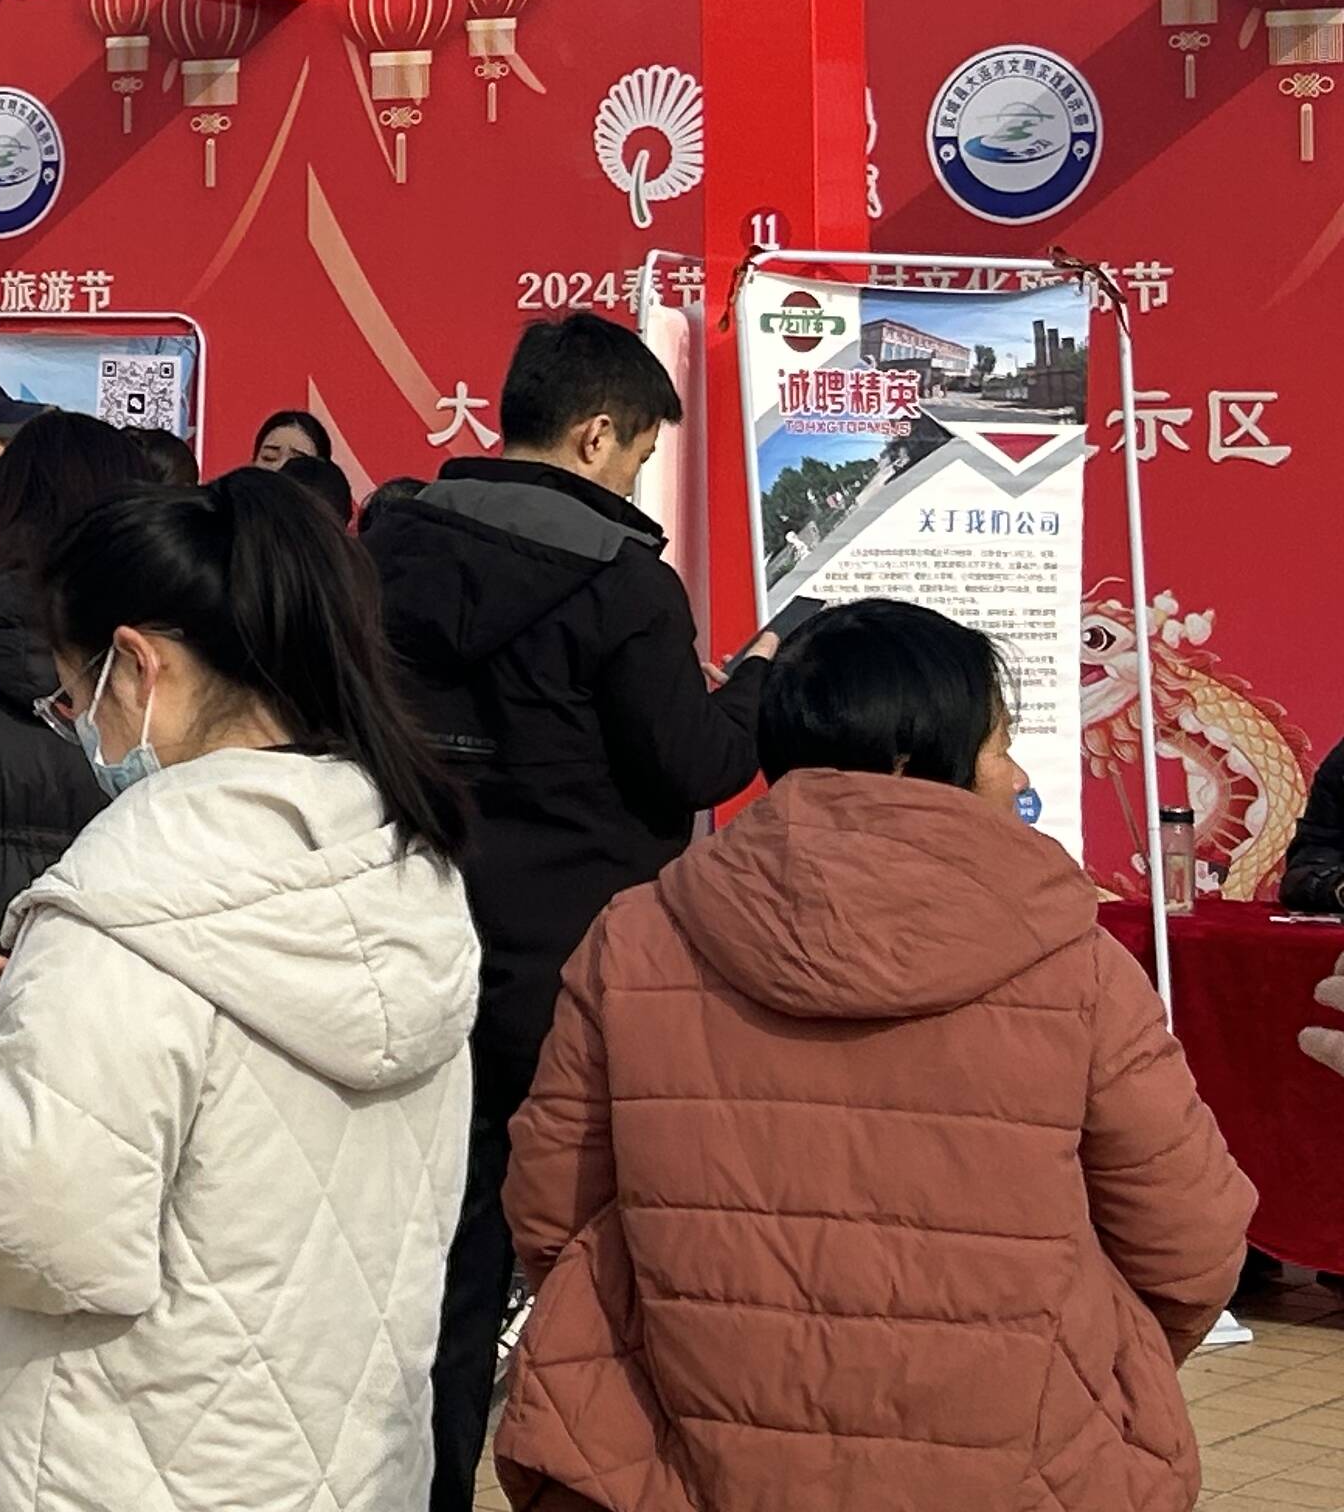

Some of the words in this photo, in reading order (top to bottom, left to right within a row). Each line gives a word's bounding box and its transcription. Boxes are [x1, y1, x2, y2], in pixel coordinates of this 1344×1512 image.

[752, 214, 780, 249] 11
[777, 368, 920, 417] 诚聘精英
[918, 507, 1060, 535] 关于我们公司
